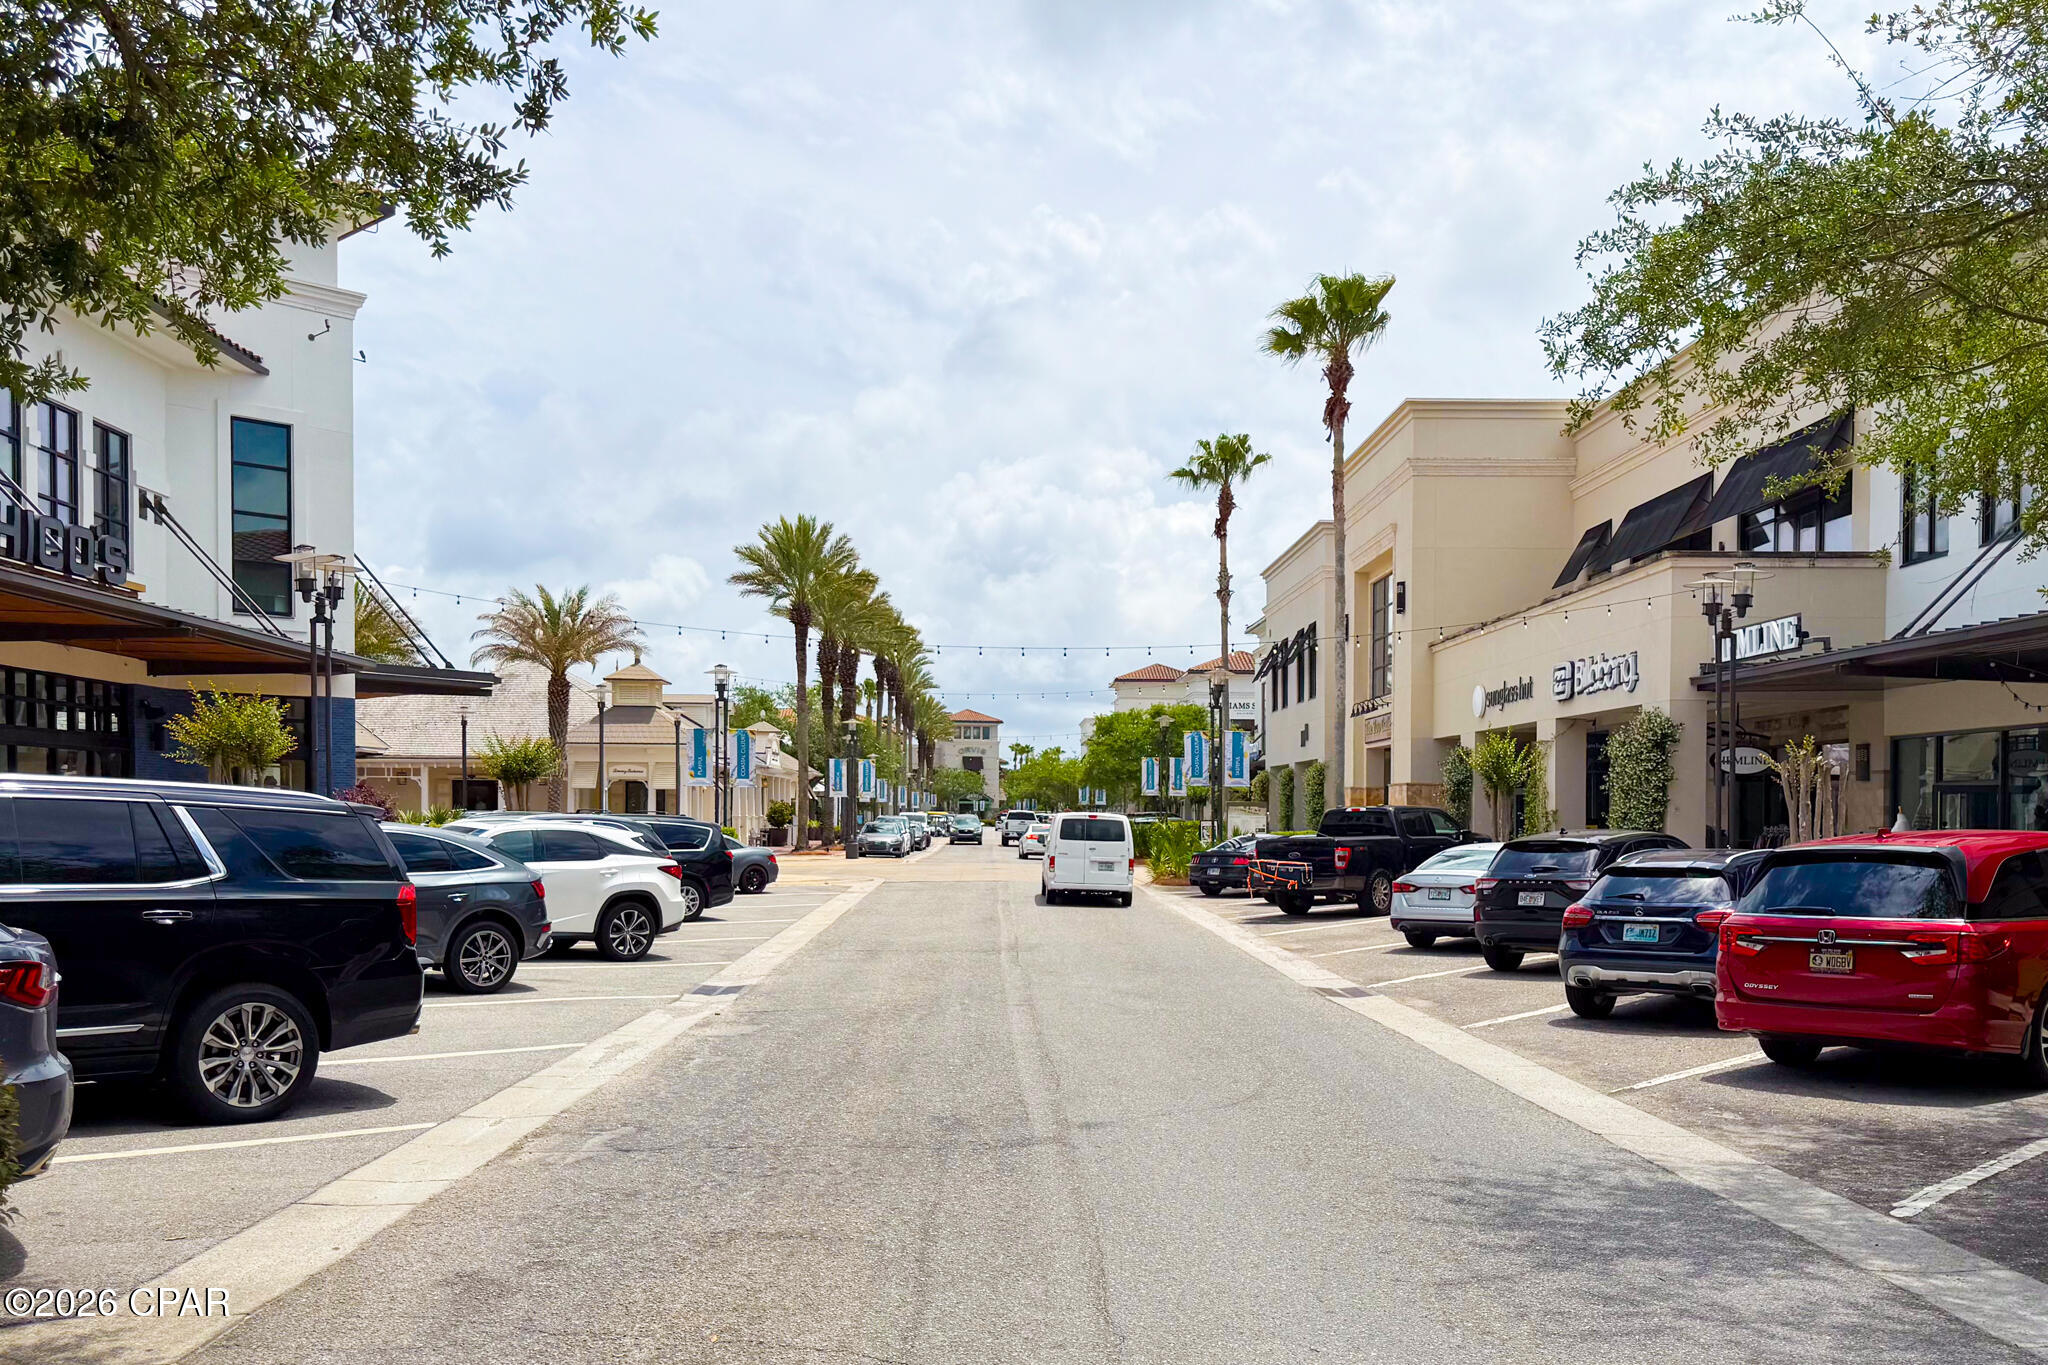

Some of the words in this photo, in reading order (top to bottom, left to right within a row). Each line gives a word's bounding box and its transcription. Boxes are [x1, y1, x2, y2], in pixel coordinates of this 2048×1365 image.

[1486, 680, 1518, 711] sunglass
[1518, 676, 1534, 700] hut
[1744, 982, 1779, 990] ODYSSEY
